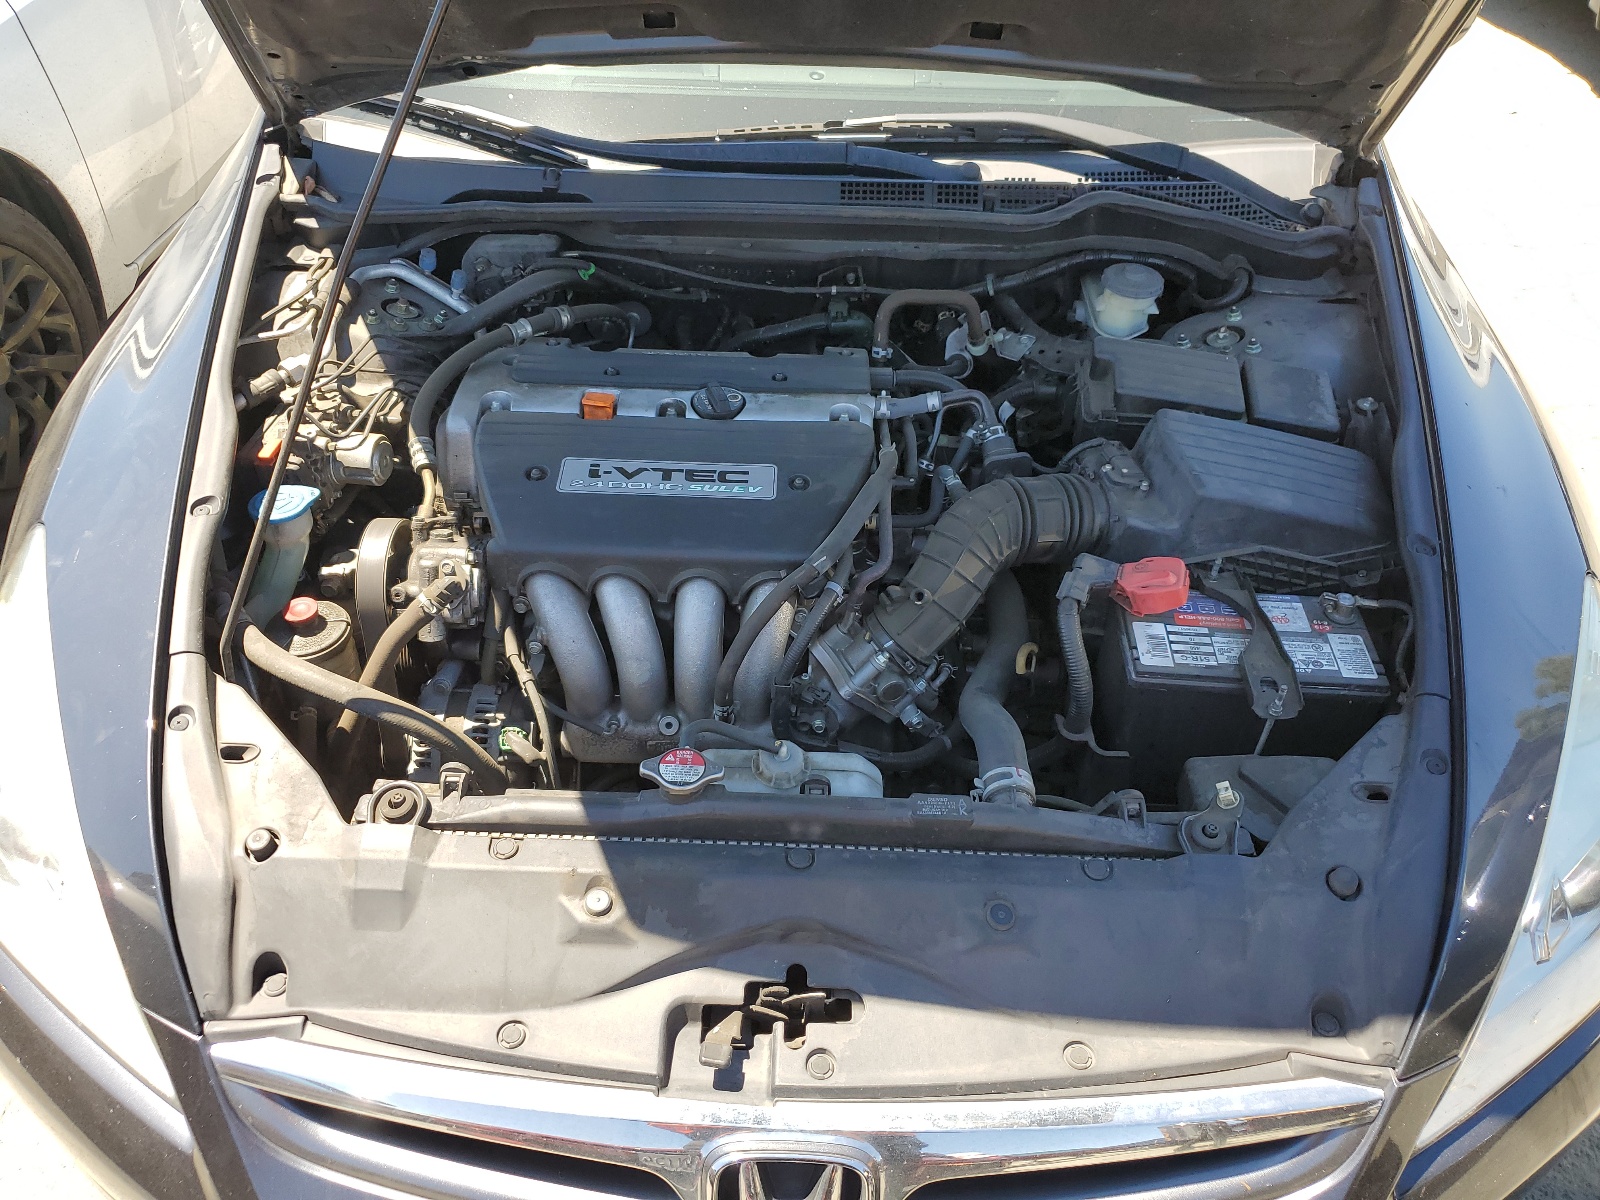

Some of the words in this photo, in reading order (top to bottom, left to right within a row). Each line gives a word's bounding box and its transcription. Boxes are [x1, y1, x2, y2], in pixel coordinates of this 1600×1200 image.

[588, 463, 750, 484] i-VTEC
[608, 481, 684, 492] DOHC
[687, 484, 763, 493] SULEV
[1180, 654, 1210, 662] 51R-C
